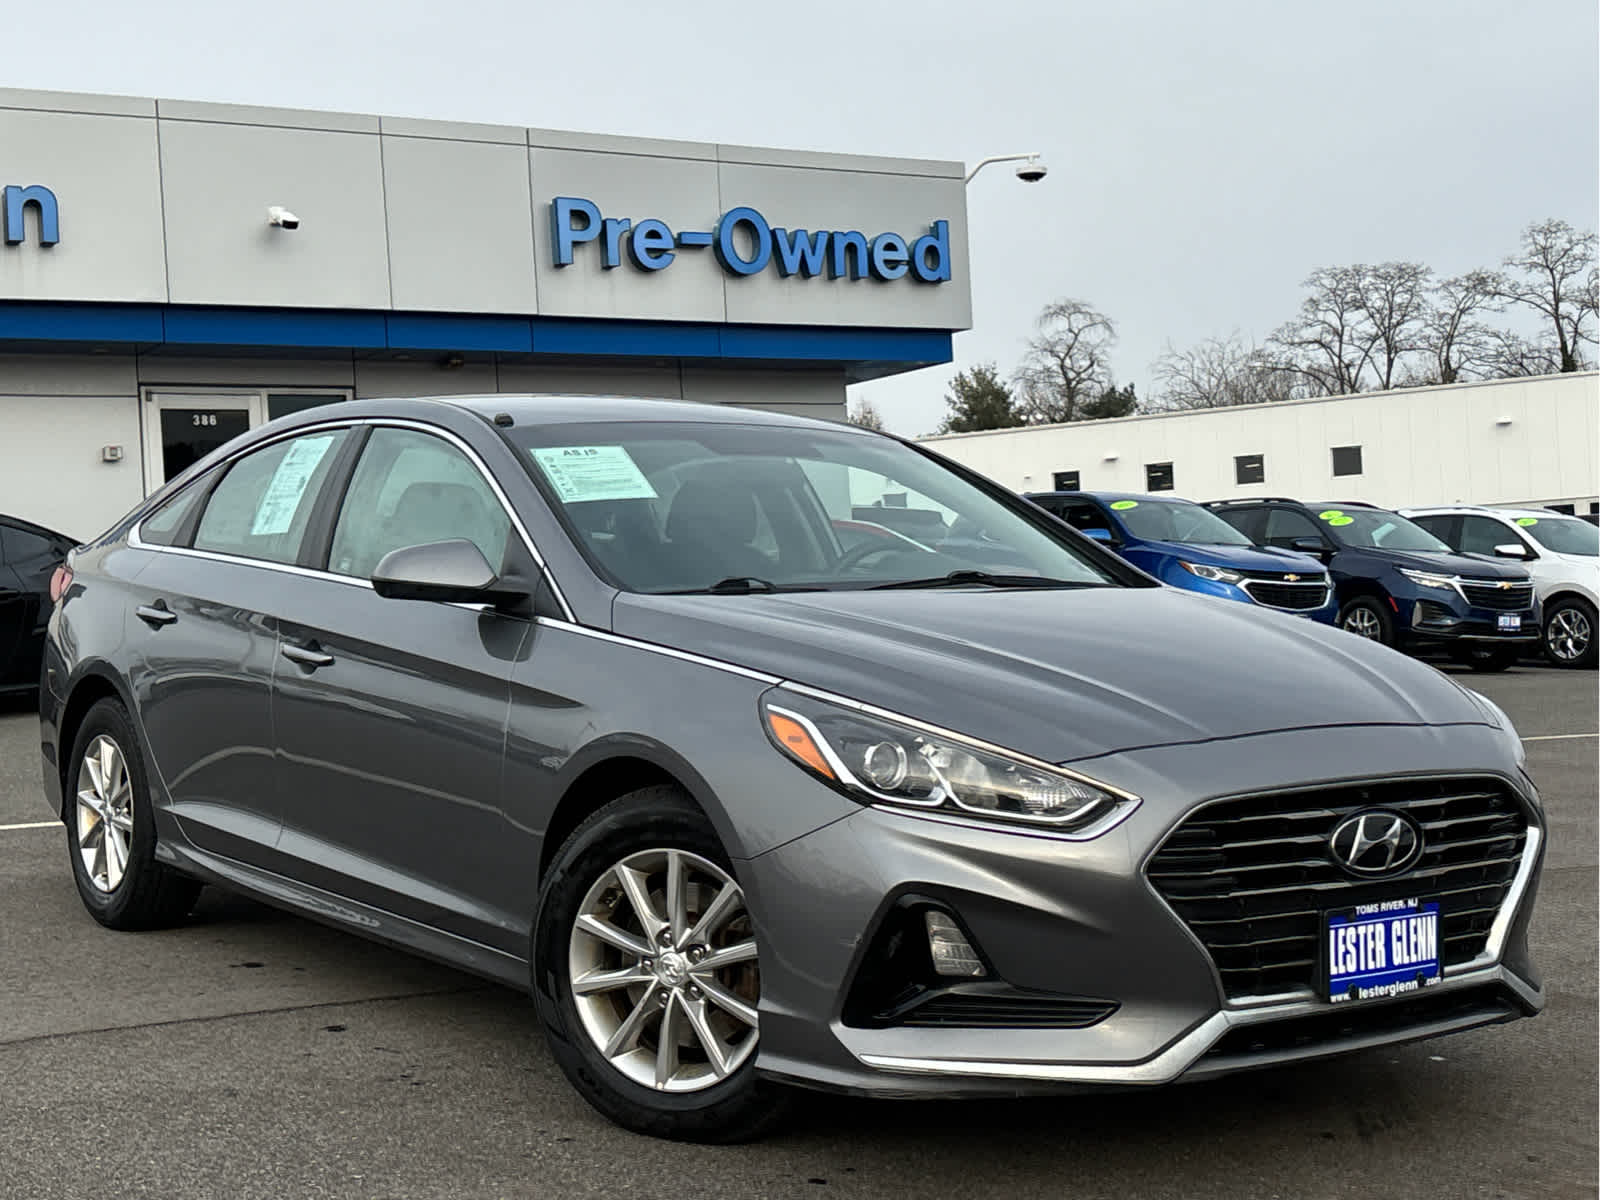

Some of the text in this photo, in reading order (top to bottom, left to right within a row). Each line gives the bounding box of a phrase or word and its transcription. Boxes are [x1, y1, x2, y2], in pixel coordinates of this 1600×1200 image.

[551, 196, 952, 284] Pre-Owned
[192, 414, 217, 426] 386
[583, 448, 598, 457] IS
[1355, 903, 1379, 915] TOMS
[1407, 898, 1418, 908] NJ
[1329, 915, 1437, 976] LESTER GLENN
